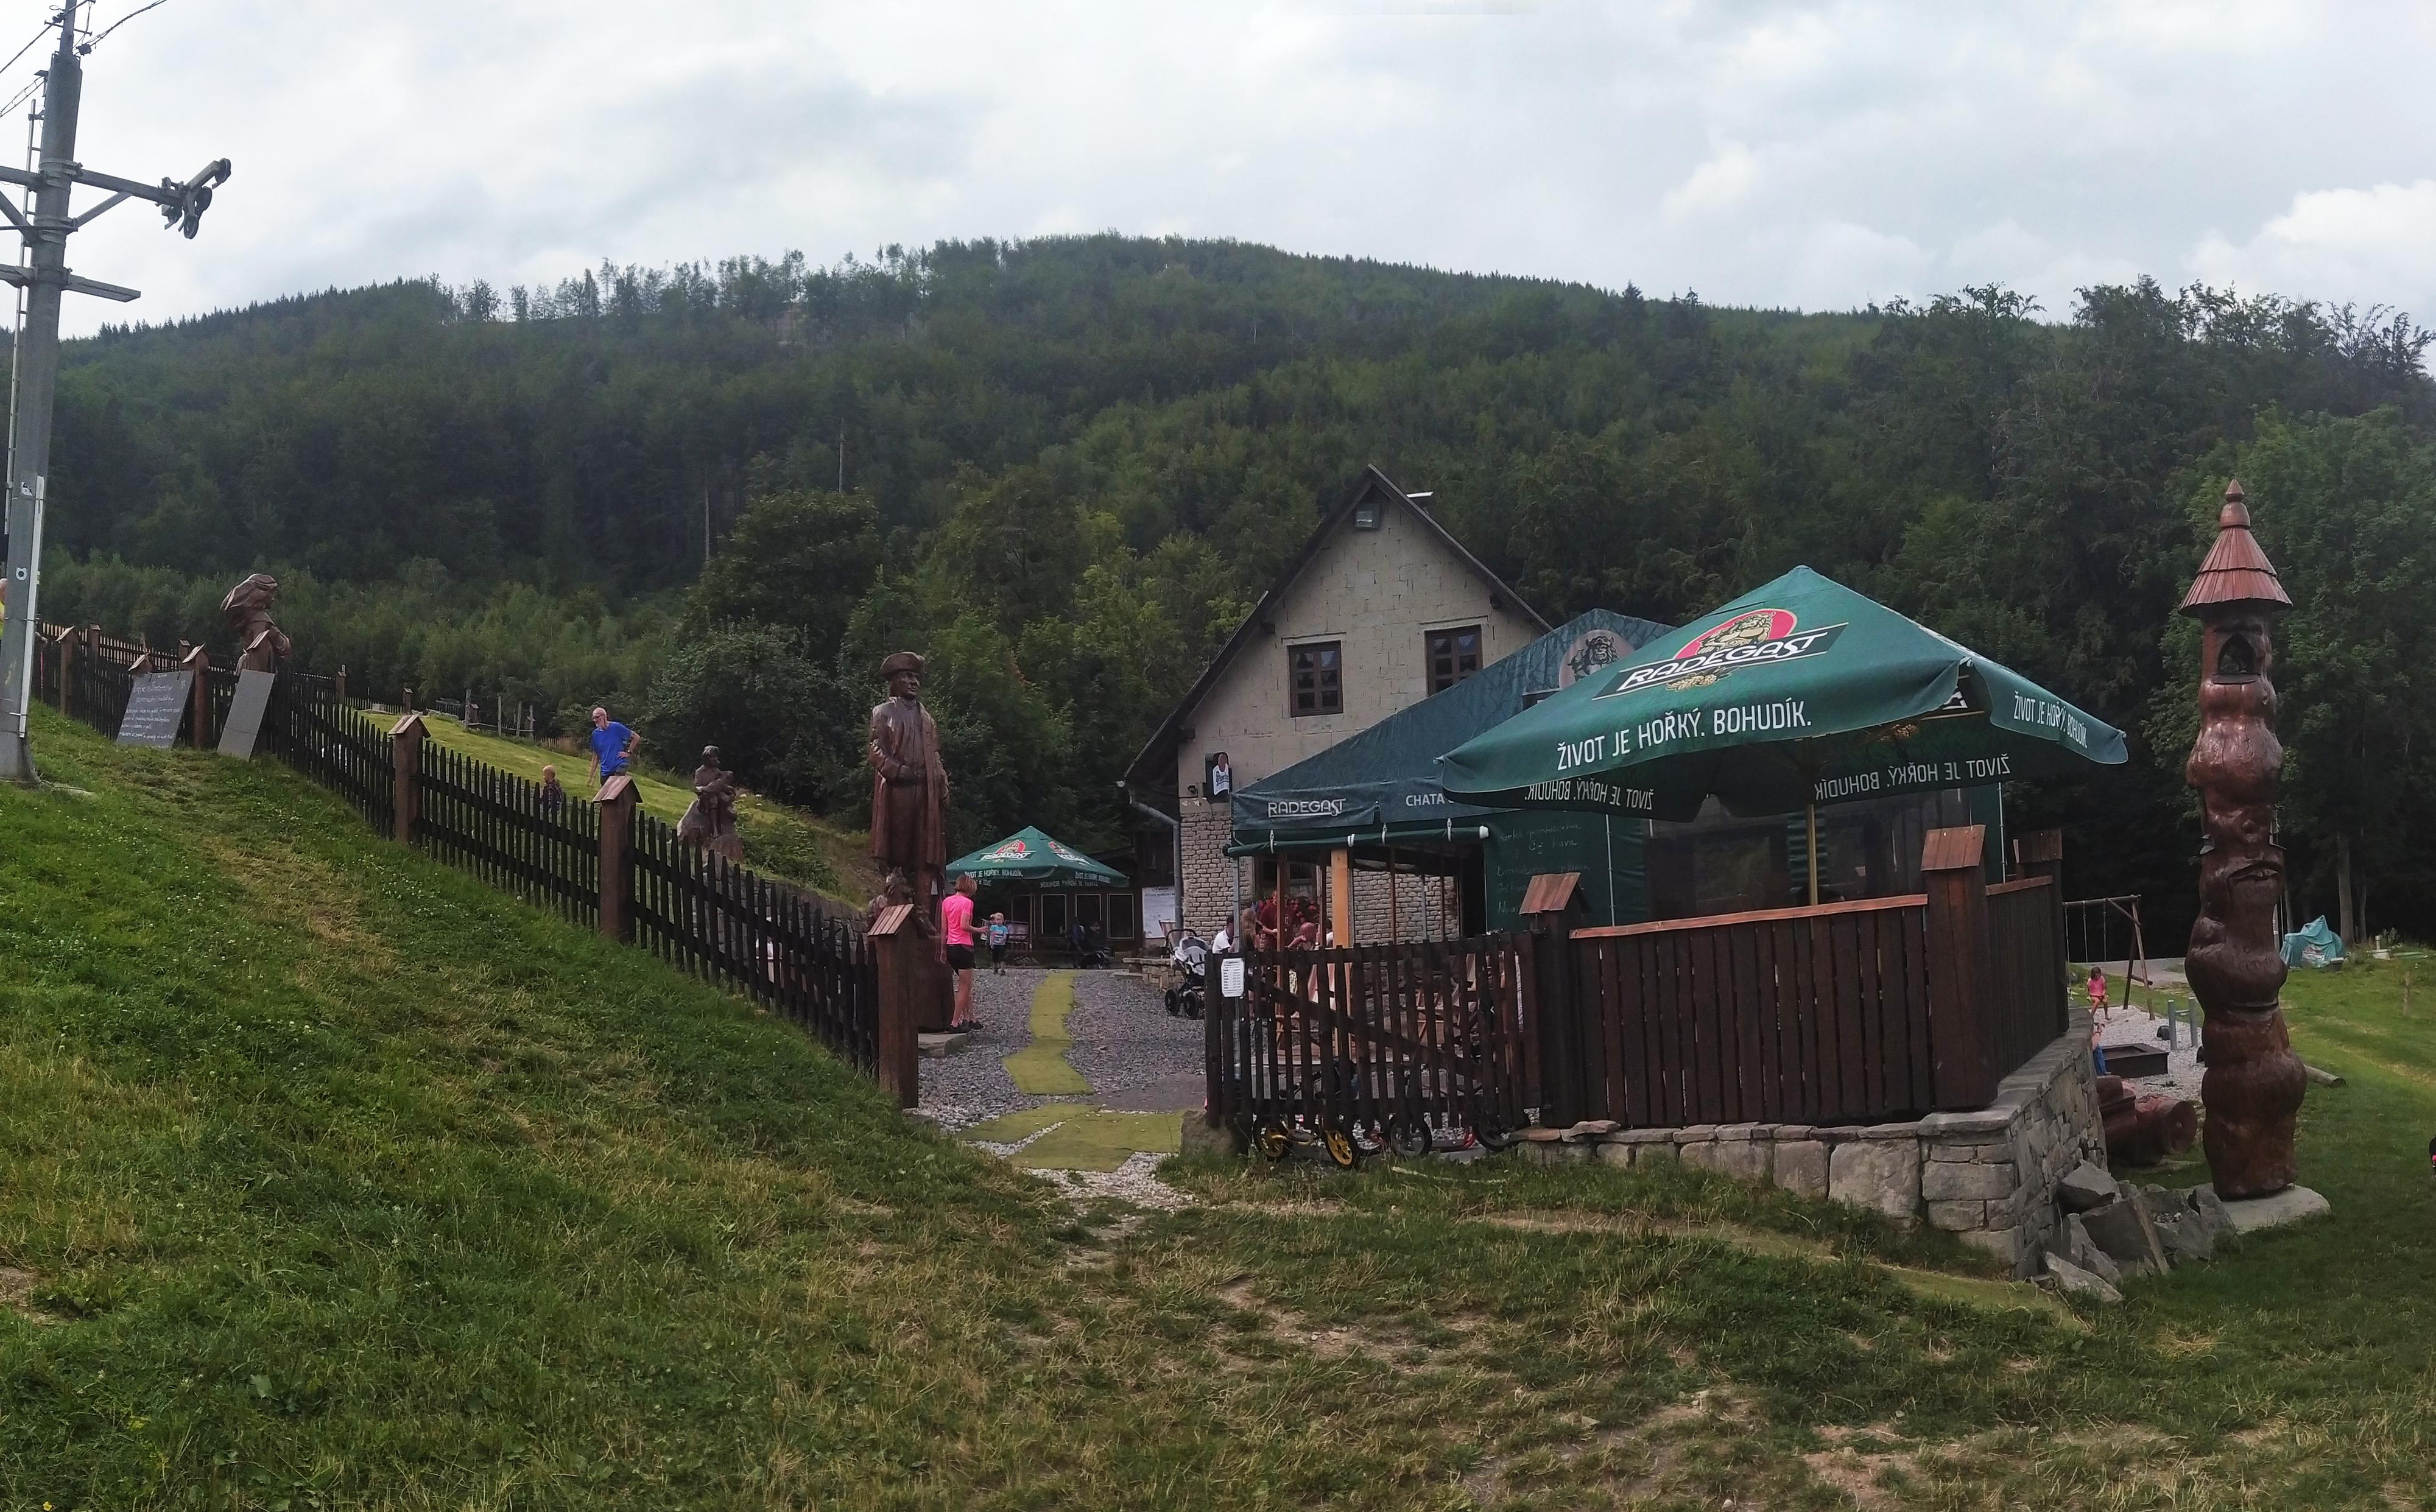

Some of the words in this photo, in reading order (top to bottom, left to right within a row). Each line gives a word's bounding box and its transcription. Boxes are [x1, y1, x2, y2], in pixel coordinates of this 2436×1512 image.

[1617, 631, 1828, 692] RADEGAST
[2014, 691, 2036, 722] ŽIVOT
[2037, 701, 2045, 725] JE
[1557, 736, 1605, 771] ŽIVOT
[1612, 729, 1630, 757] JE
[1638, 708, 1705, 749] HOŘKÝ.
[1714, 697, 1812, 735] BOHUDÍK.
[1268, 798, 1346, 818] RADEGAST
[1406, 793, 1445, 807] CHATA
